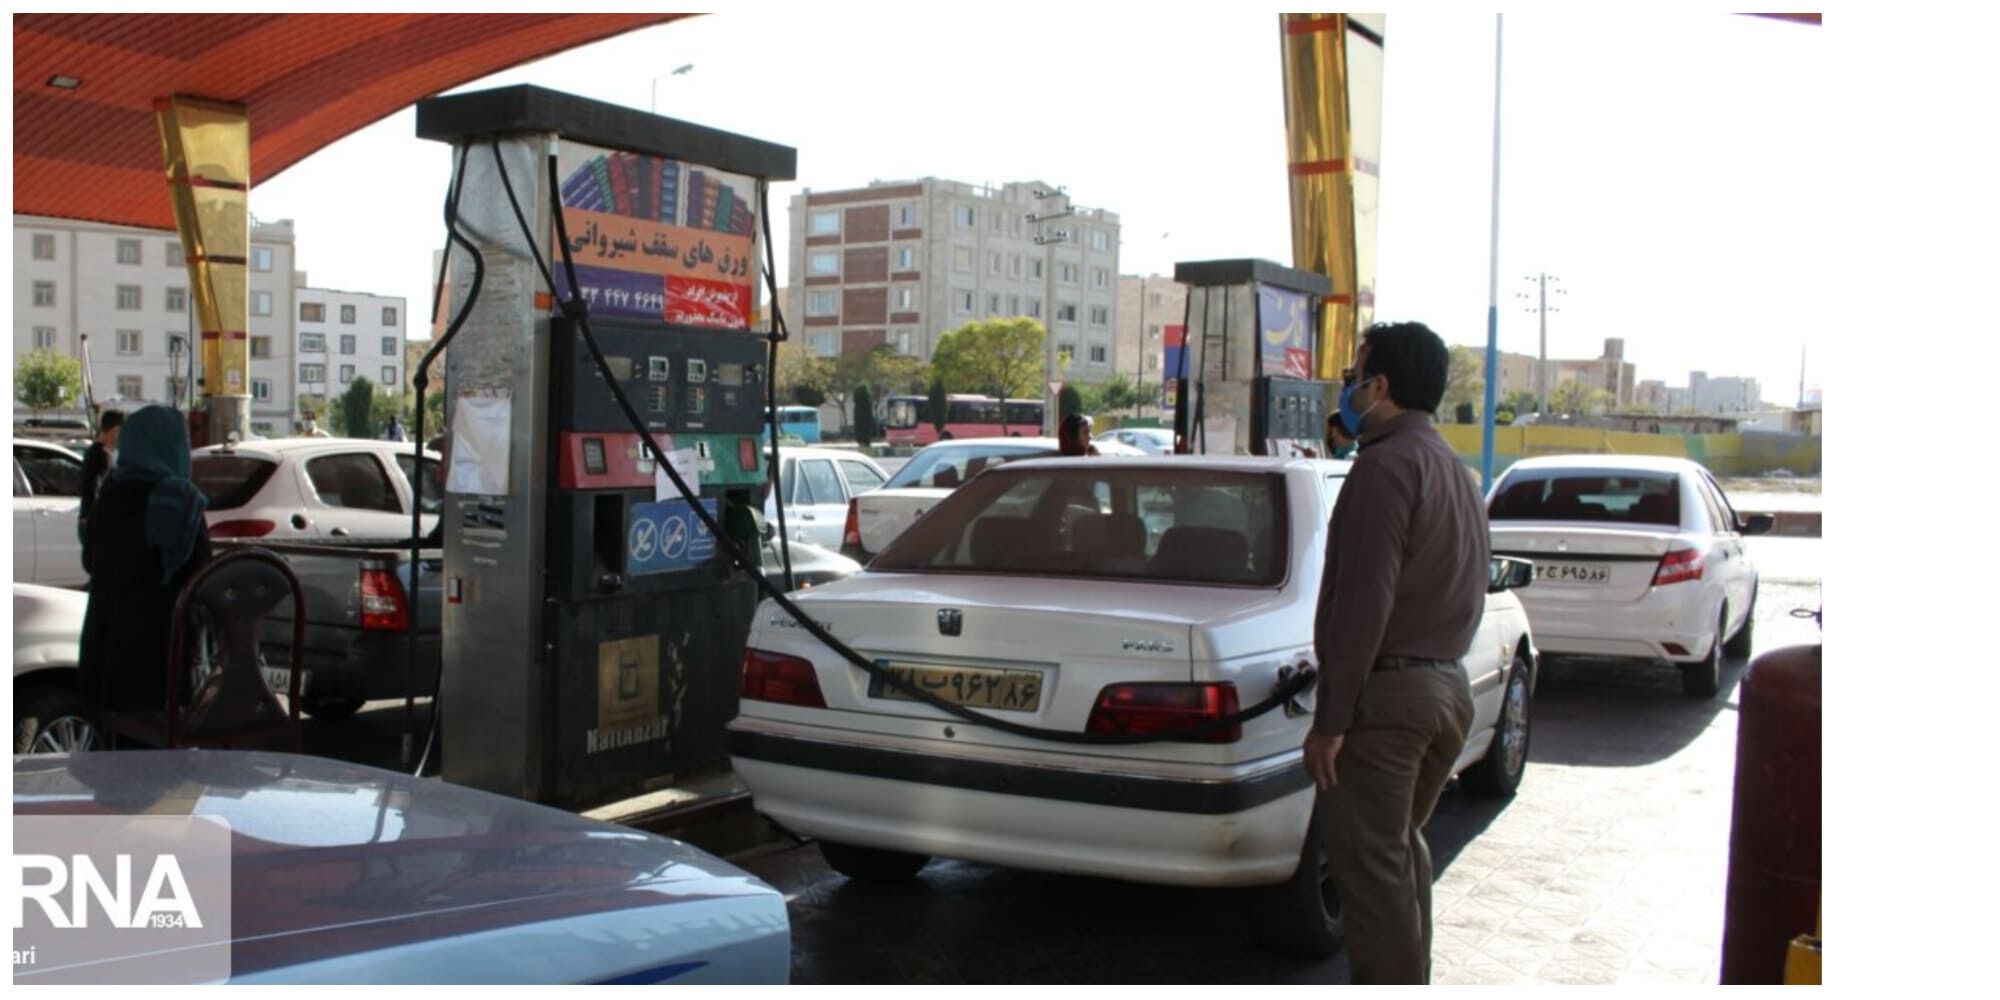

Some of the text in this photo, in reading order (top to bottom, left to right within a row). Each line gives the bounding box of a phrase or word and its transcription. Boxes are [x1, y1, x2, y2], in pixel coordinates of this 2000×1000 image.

[568, 219, 749, 276] ورق های سقف شیروانی
